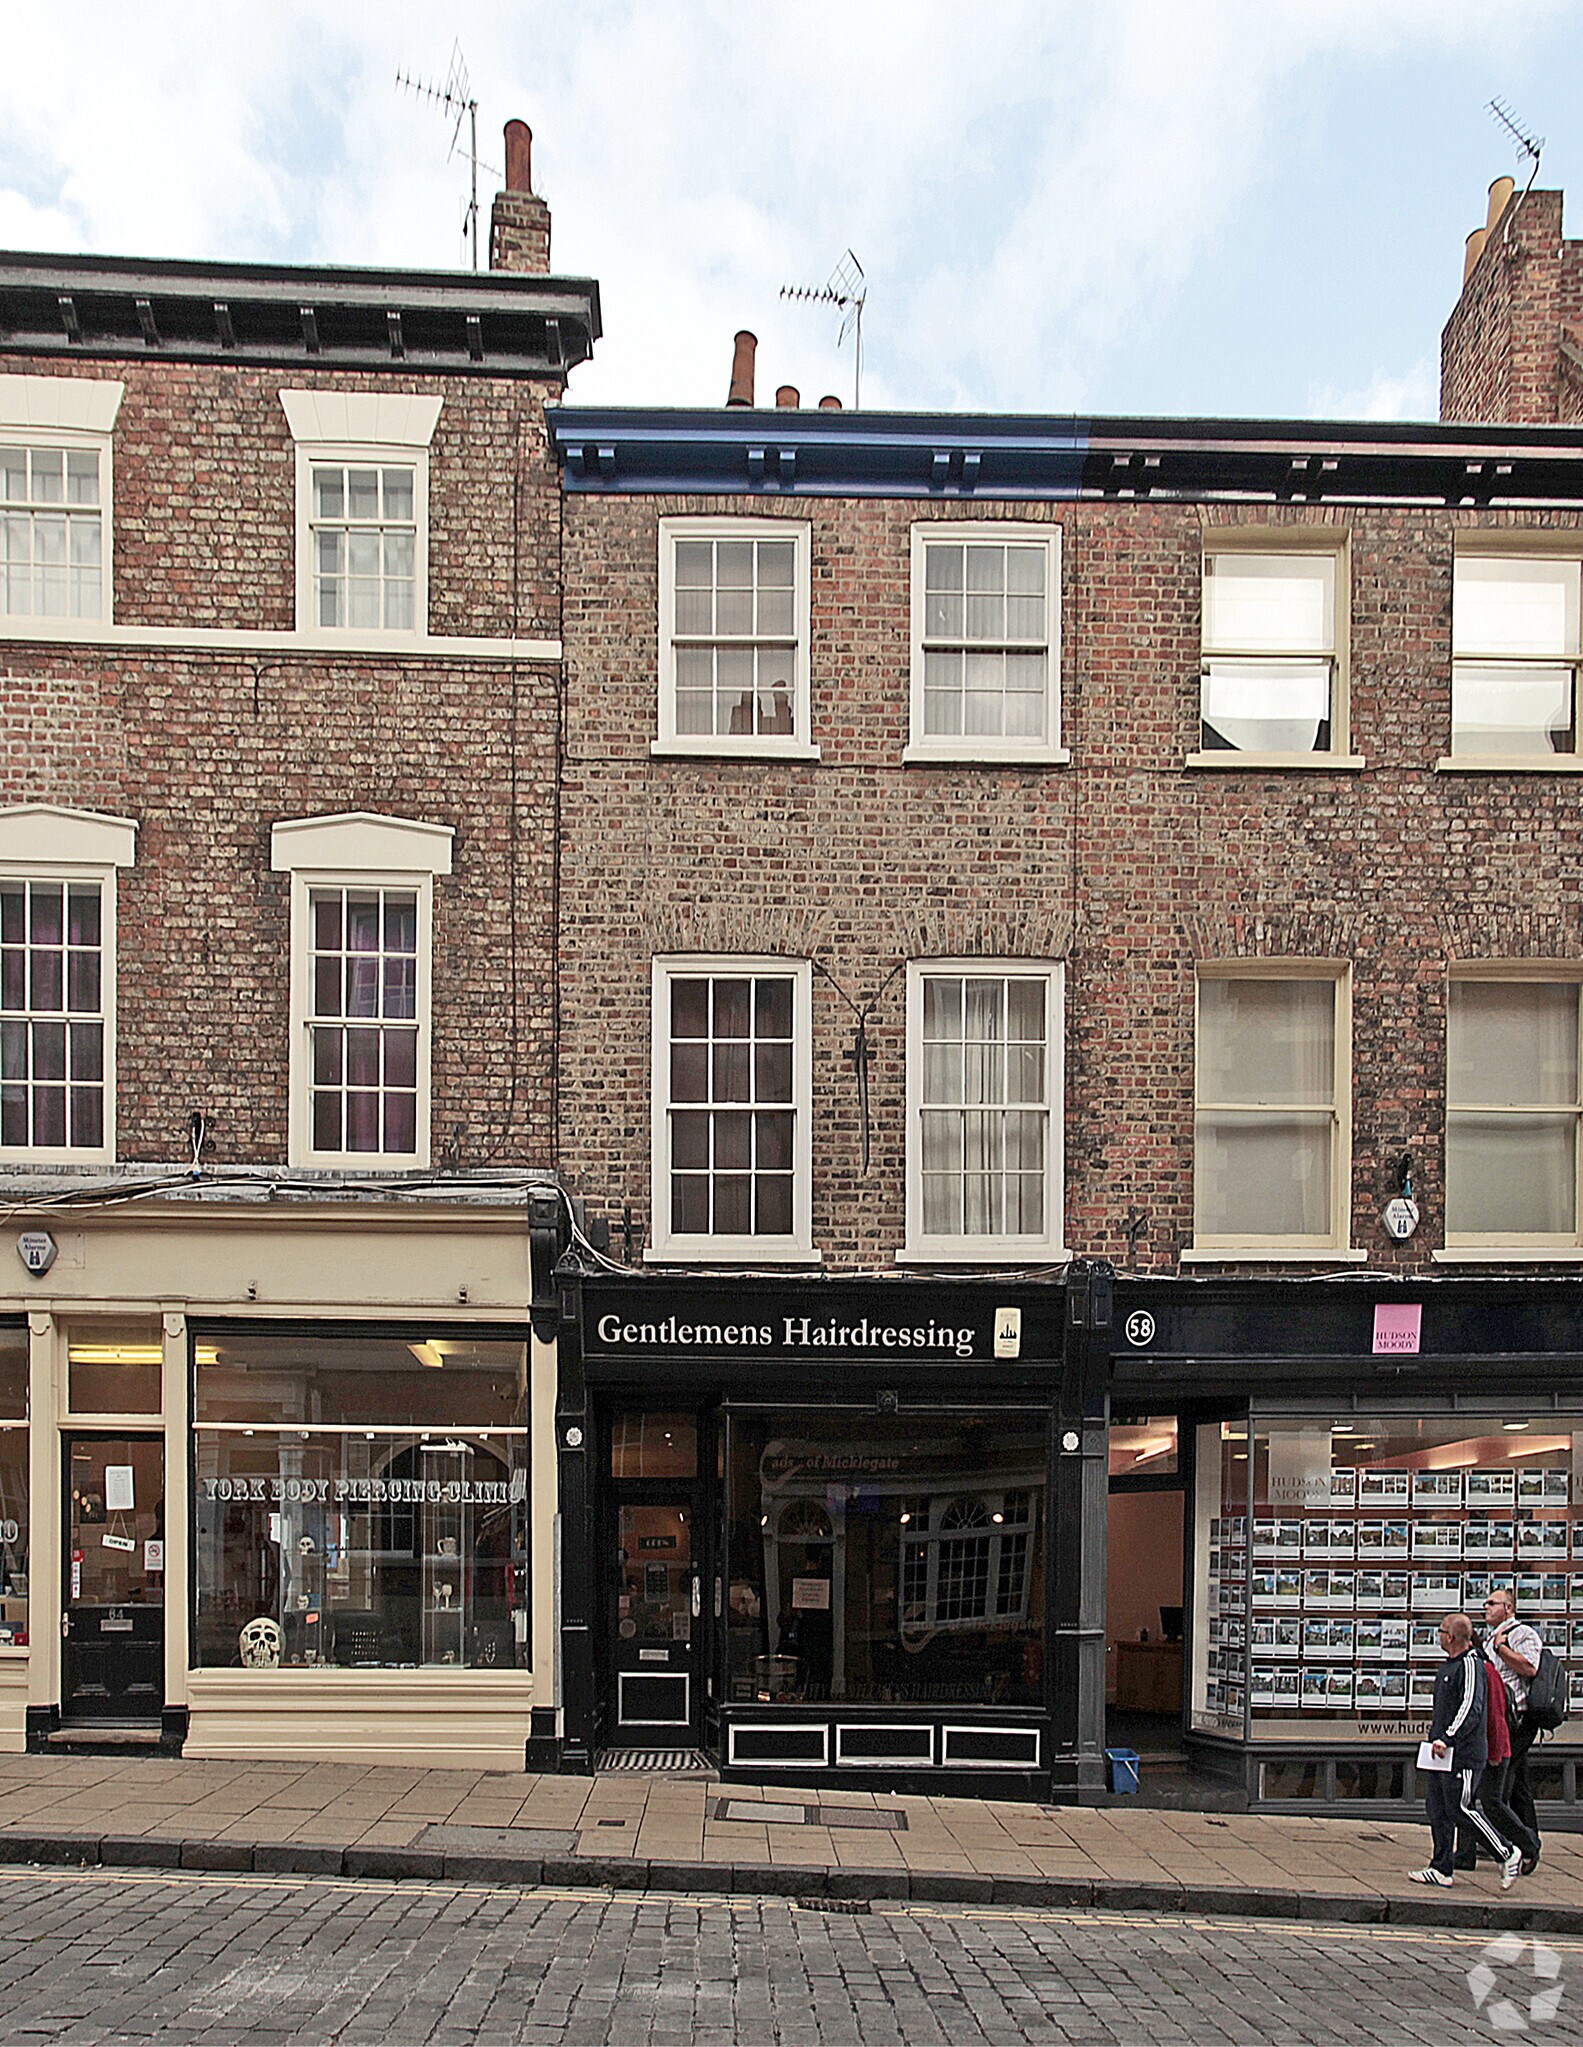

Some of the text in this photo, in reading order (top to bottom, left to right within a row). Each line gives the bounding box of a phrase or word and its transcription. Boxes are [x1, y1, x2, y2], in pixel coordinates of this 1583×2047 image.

[598, 1314, 976, 1357] Gentlemens Hairdressing
[1130, 1318, 1151, 1338] 58
[1375, 1331, 1417, 1340] HUDSON
[1377, 1340, 1414, 1349] MOODY
[204, 1478, 267, 1501] YORK
[334, 1478, 442, 1503] PIERCING
